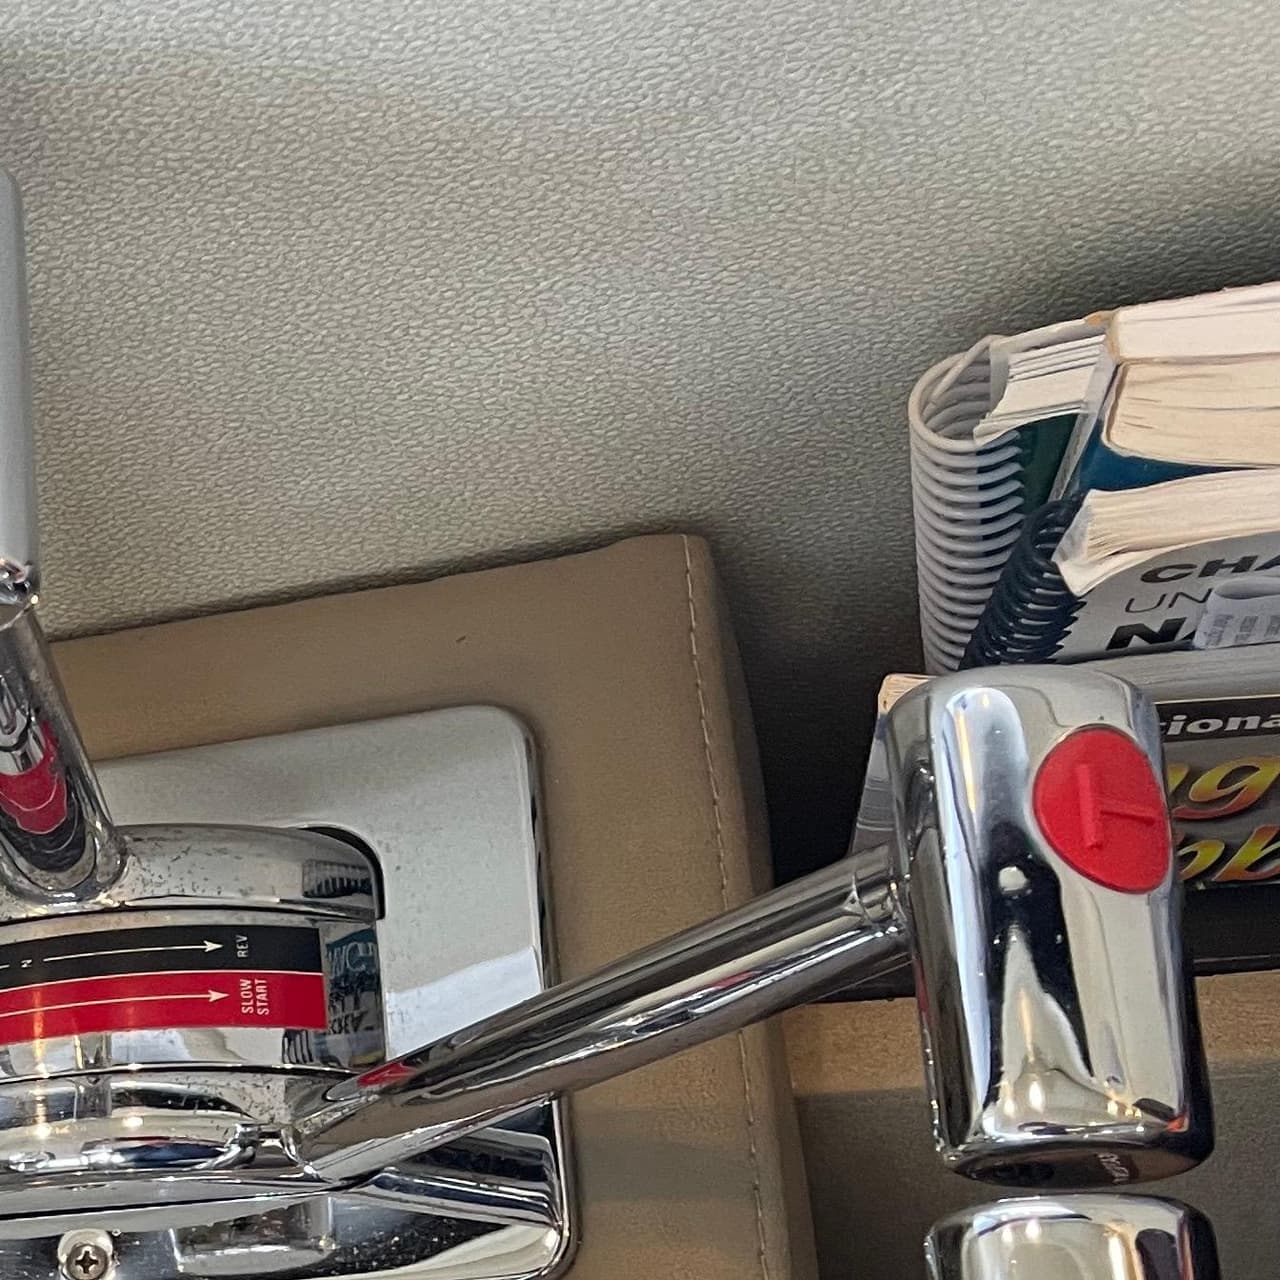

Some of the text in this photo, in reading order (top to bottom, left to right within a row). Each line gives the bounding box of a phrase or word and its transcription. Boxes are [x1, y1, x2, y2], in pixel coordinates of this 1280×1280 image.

[1105, 617, 1197, 651] N
[235, 934, 248, 958] REV
[240, 979, 254, 1014] SLOW
[254, 979, 269, 1015] START
